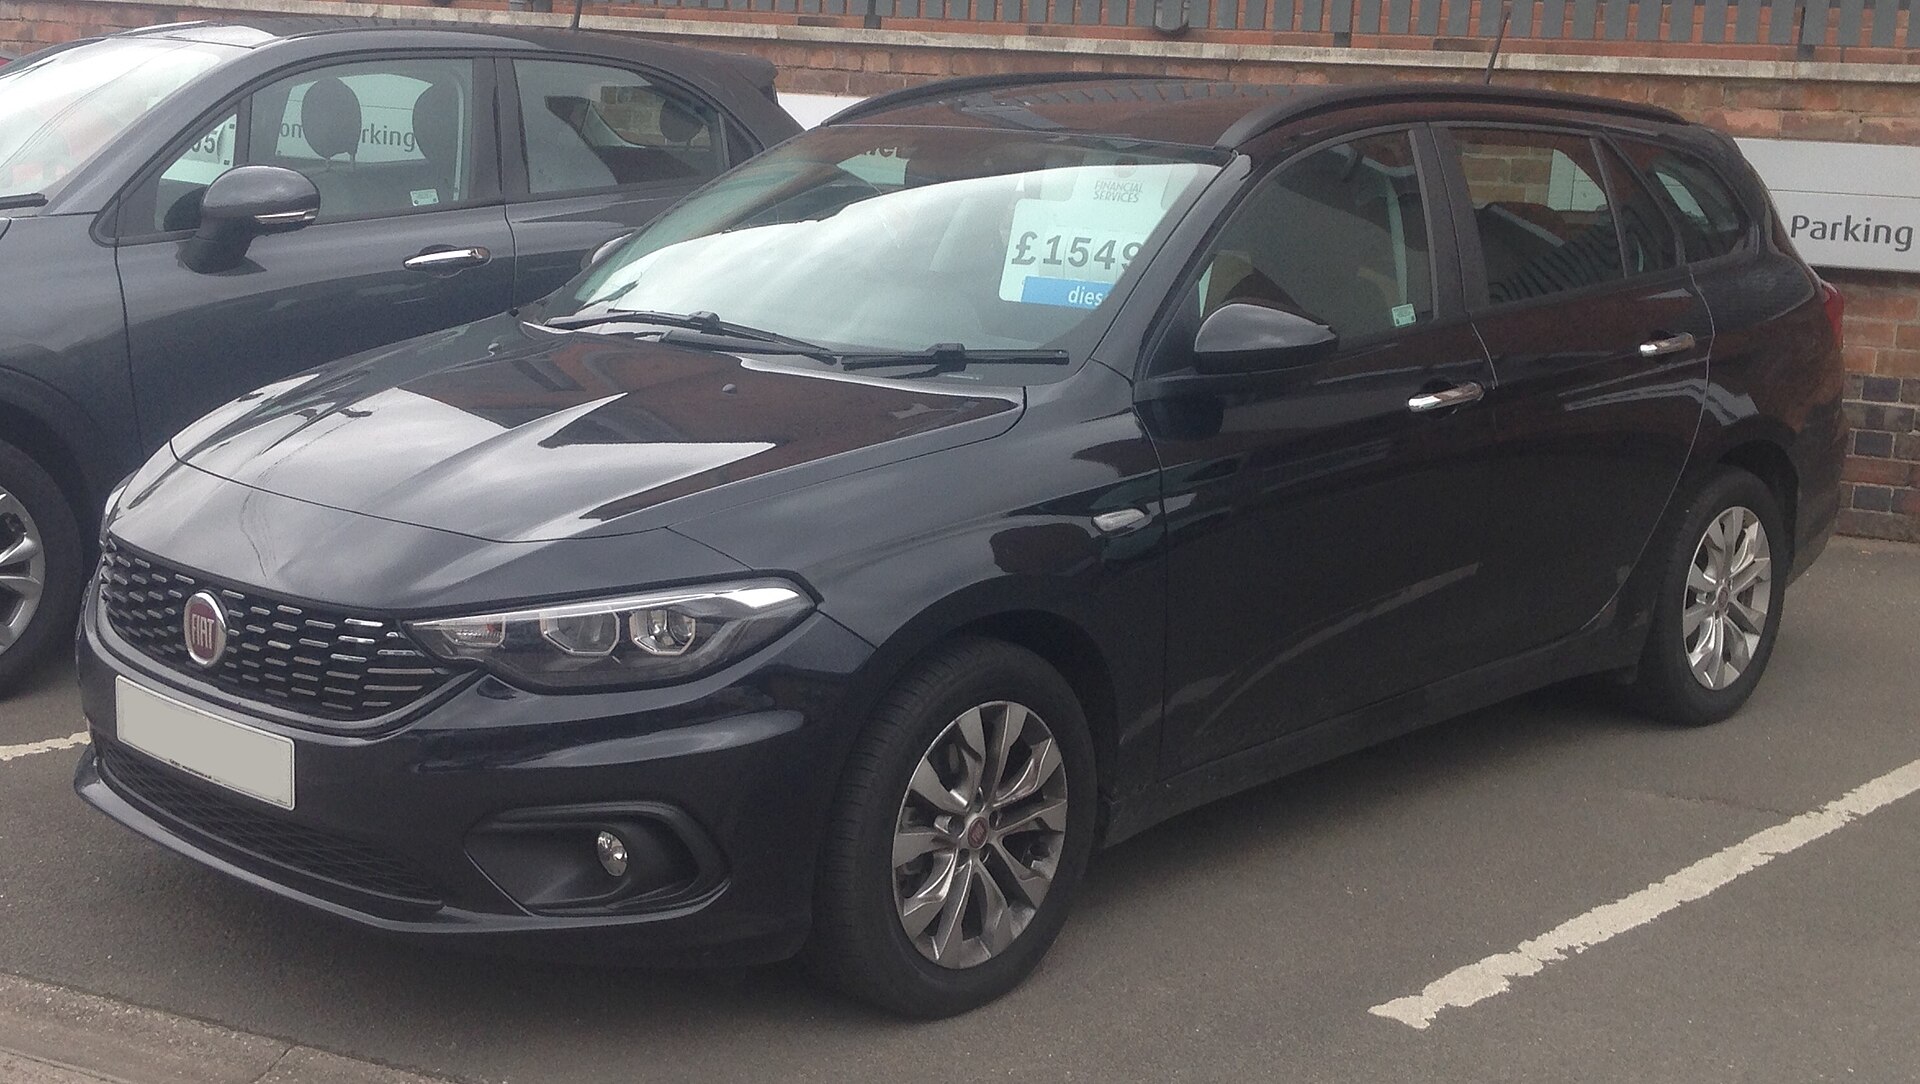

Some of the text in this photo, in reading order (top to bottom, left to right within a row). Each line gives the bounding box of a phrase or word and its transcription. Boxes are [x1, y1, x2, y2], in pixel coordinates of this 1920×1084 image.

[1093, 189, 1140, 203] SERVICES
[1094, 180, 1144, 194] FINANCIAL
[1790, 214, 1914, 253] Parking
[191, 613, 215, 650] FIAT
